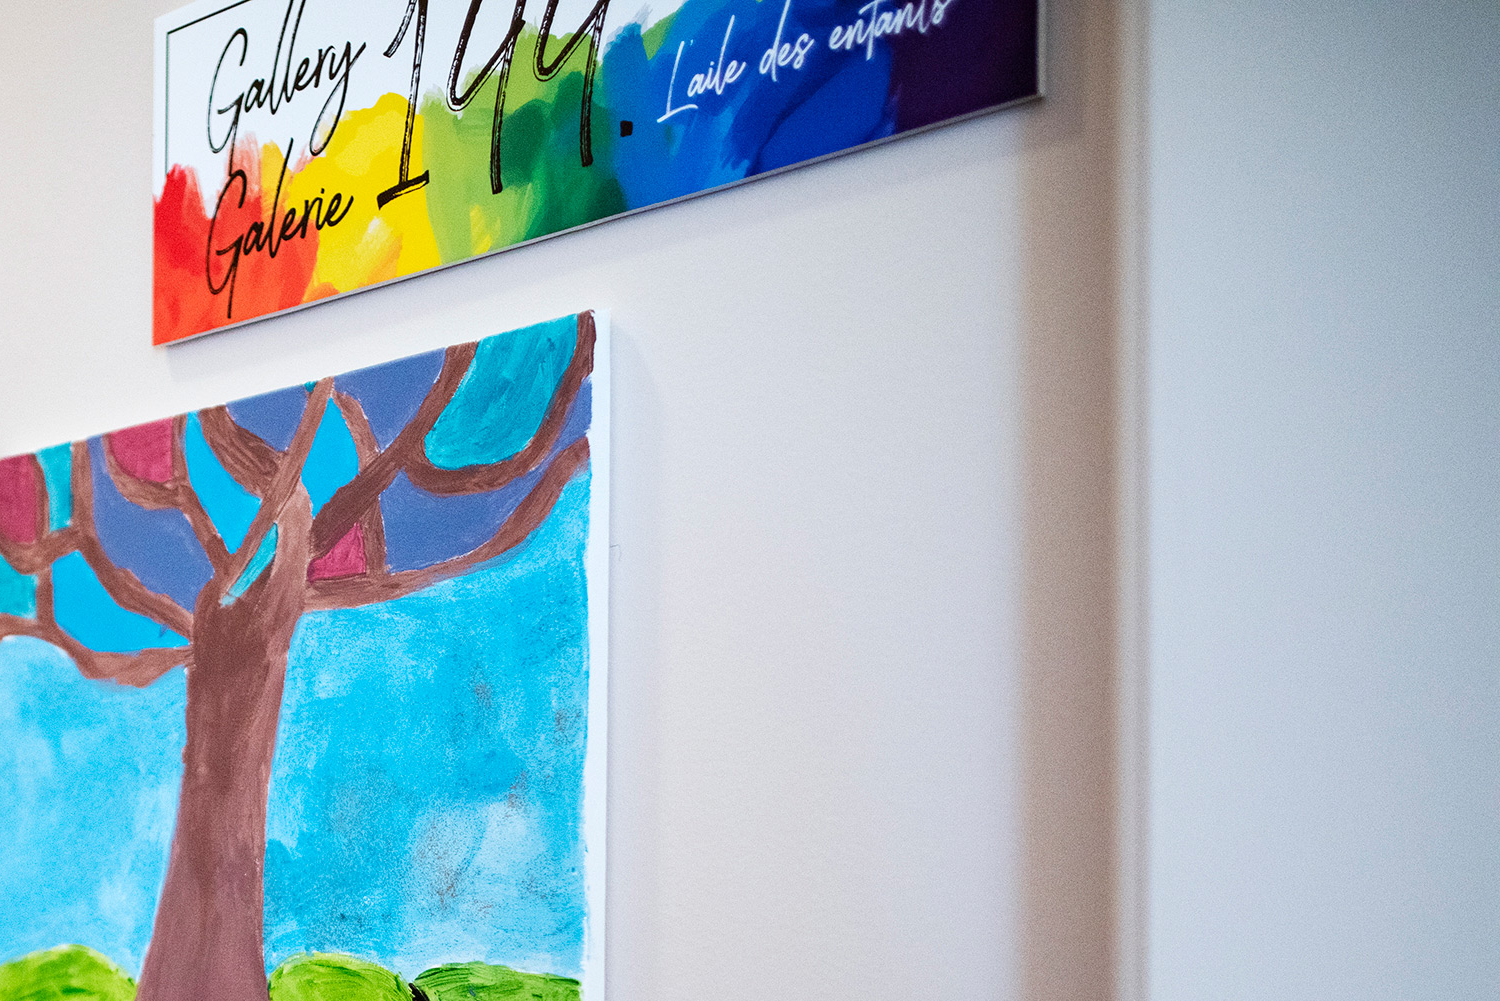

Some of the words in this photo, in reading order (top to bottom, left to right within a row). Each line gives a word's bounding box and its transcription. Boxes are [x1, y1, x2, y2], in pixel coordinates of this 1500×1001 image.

[207, 0, 367, 174] Gallery
[758, 0, 815, 82] des
[206, 137, 355, 319] Galerie
